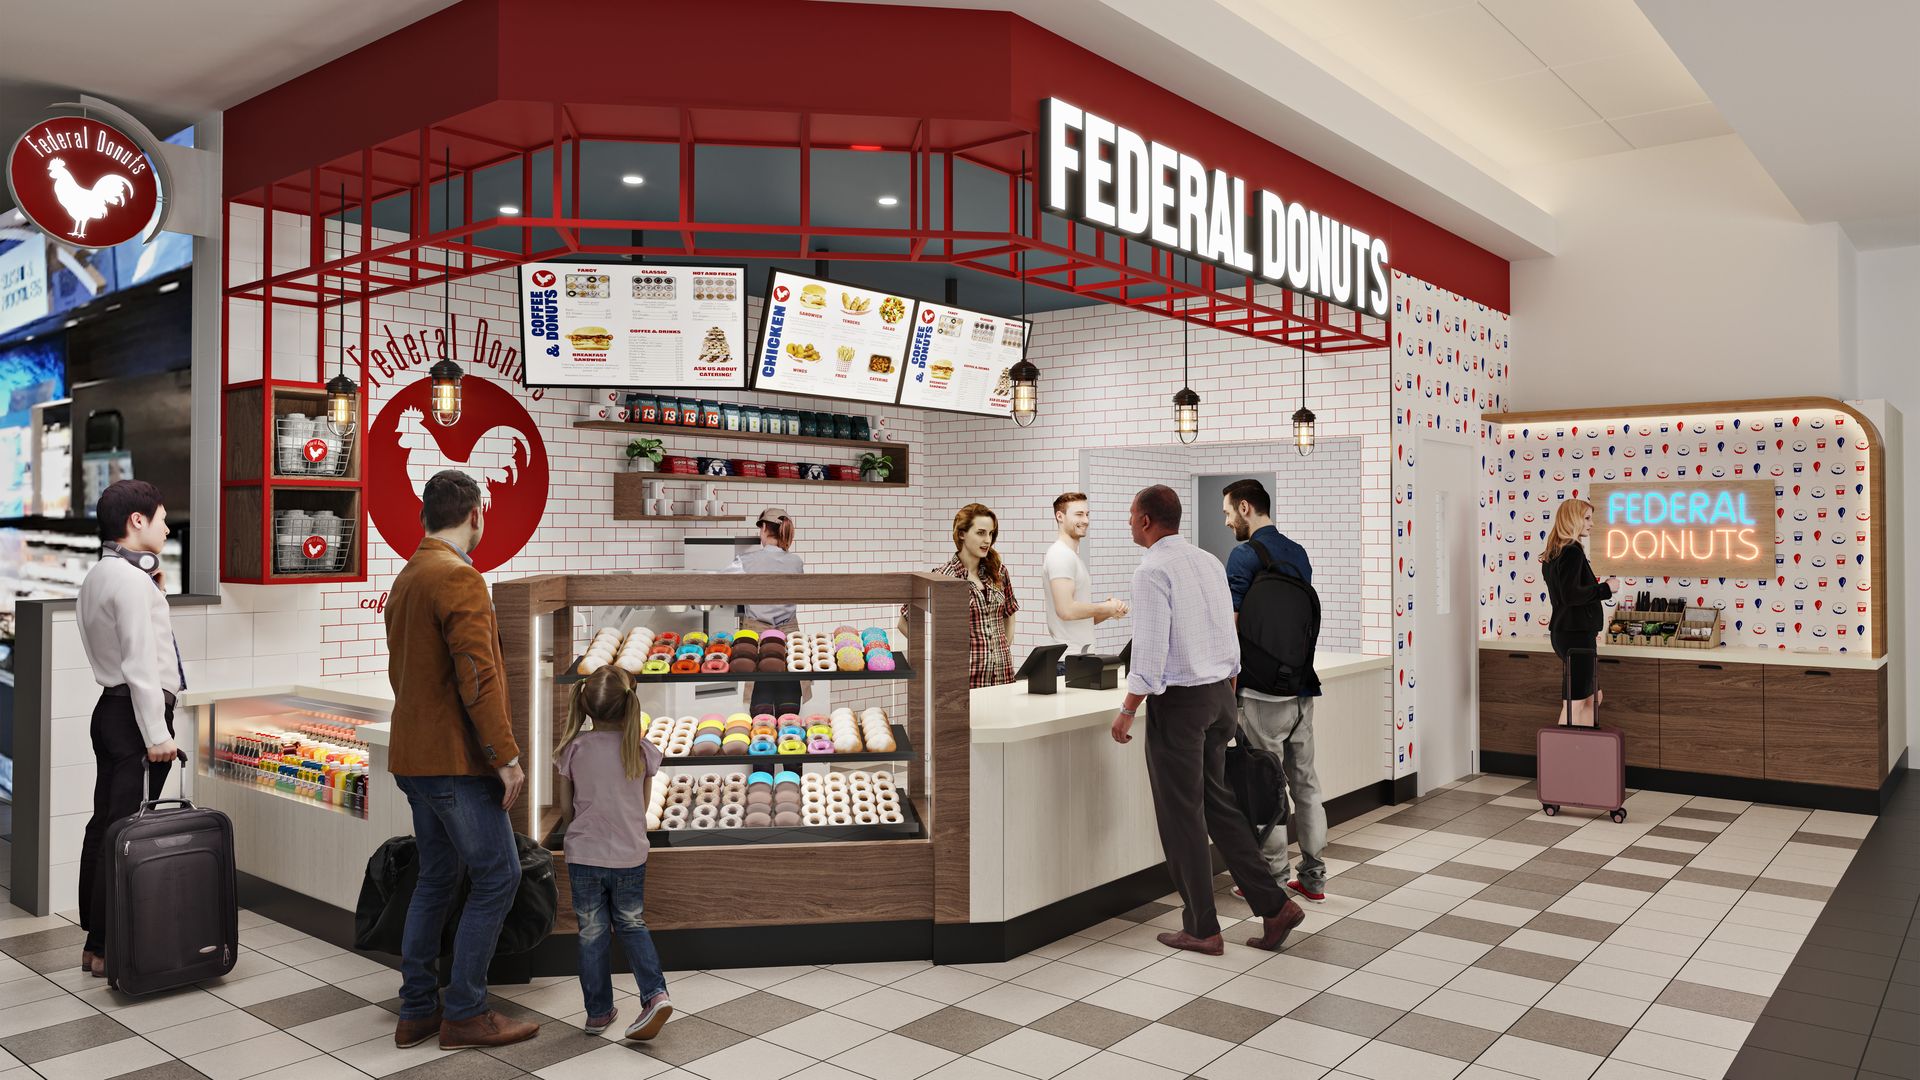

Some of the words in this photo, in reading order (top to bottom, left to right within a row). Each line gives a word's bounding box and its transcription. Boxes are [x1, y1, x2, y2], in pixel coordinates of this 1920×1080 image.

[24, 125, 88, 158] Federal
[96, 130, 146, 175] Donuts
[1049, 96, 1254, 273] FEDERAL
[1261, 188, 1390, 317] DONUTS
[530, 291, 545, 337] COFFEE
[543, 289, 559, 341] DONUTS
[345, 313, 458, 389] Federal
[473, 318, 545, 401] Donu
[546, 344, 560, 358] &
[761, 305, 787, 378] CHICKEN
[911, 326, 926, 365] COFFEE
[918, 325, 933, 369] DONUTS
[915, 371, 924, 383] &
[643, 408, 656, 420] 13
[665, 410, 676, 421] 13
[684, 411, 696, 423] 13
[707, 414, 719, 425] 13
[1607, 490, 1757, 526] FEDERAL
[1606, 528, 1760, 561] DONUTS
